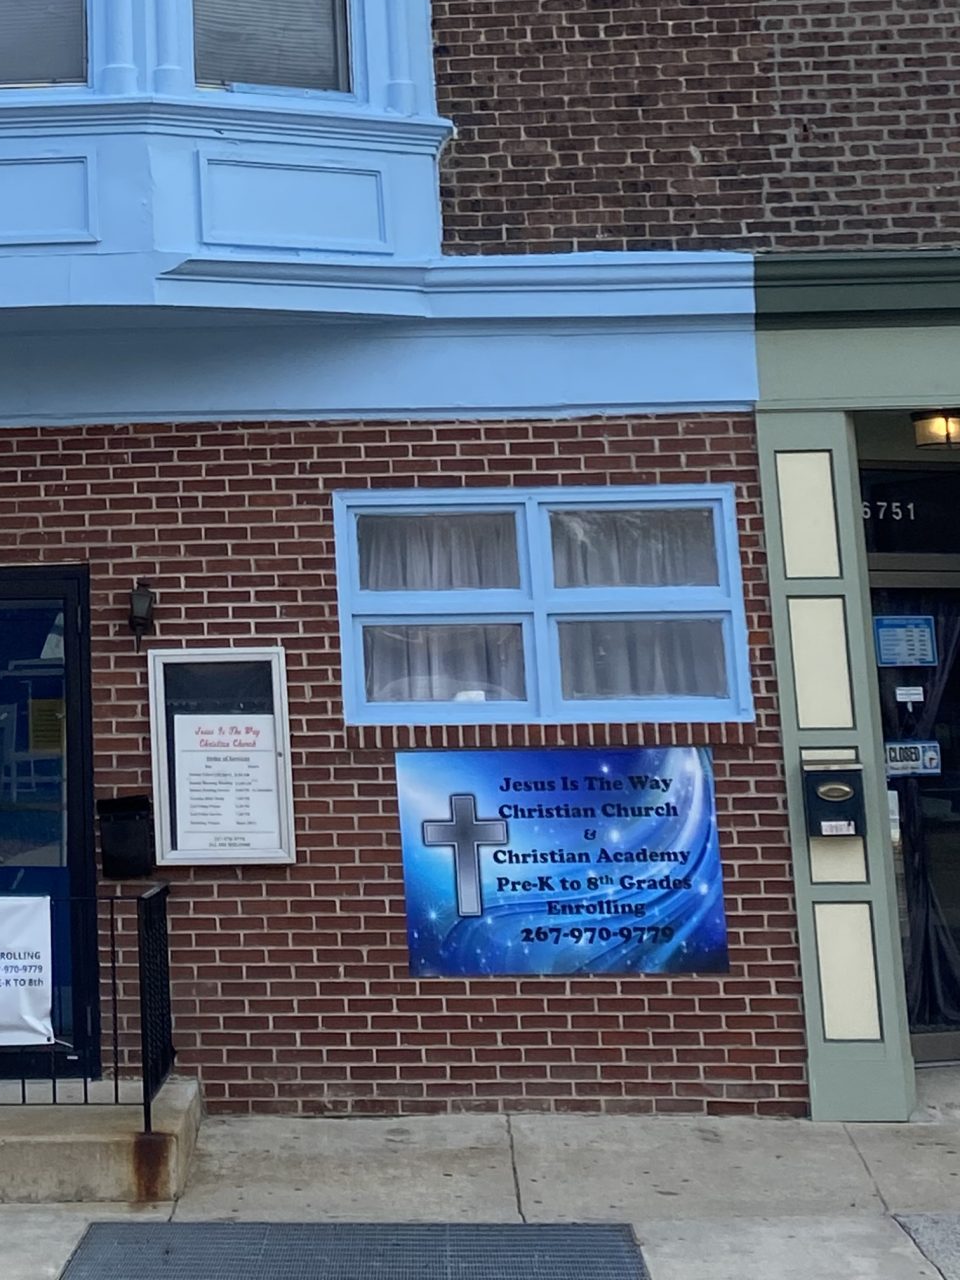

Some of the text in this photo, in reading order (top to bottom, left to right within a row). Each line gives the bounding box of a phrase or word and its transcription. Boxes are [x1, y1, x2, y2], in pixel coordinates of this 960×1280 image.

[863, 501, 915, 520] 6751
[889, 746, 920, 762] CLOSED
[499, 775, 673, 793] Jesus Is The Way
[498, 802, 679, 819] Christian Church
[583, 828, 597, 840] &
[493, 848, 691, 865] Christian Academy
[496, 875, 692, 892] Pre-K to 8th Grades
[546, 899, 647, 917] Enrolling
[520, 926, 675, 945] 267-970-9779
[14, 978, 26, 987] TO
[28, 978, 44, 987] 8th
